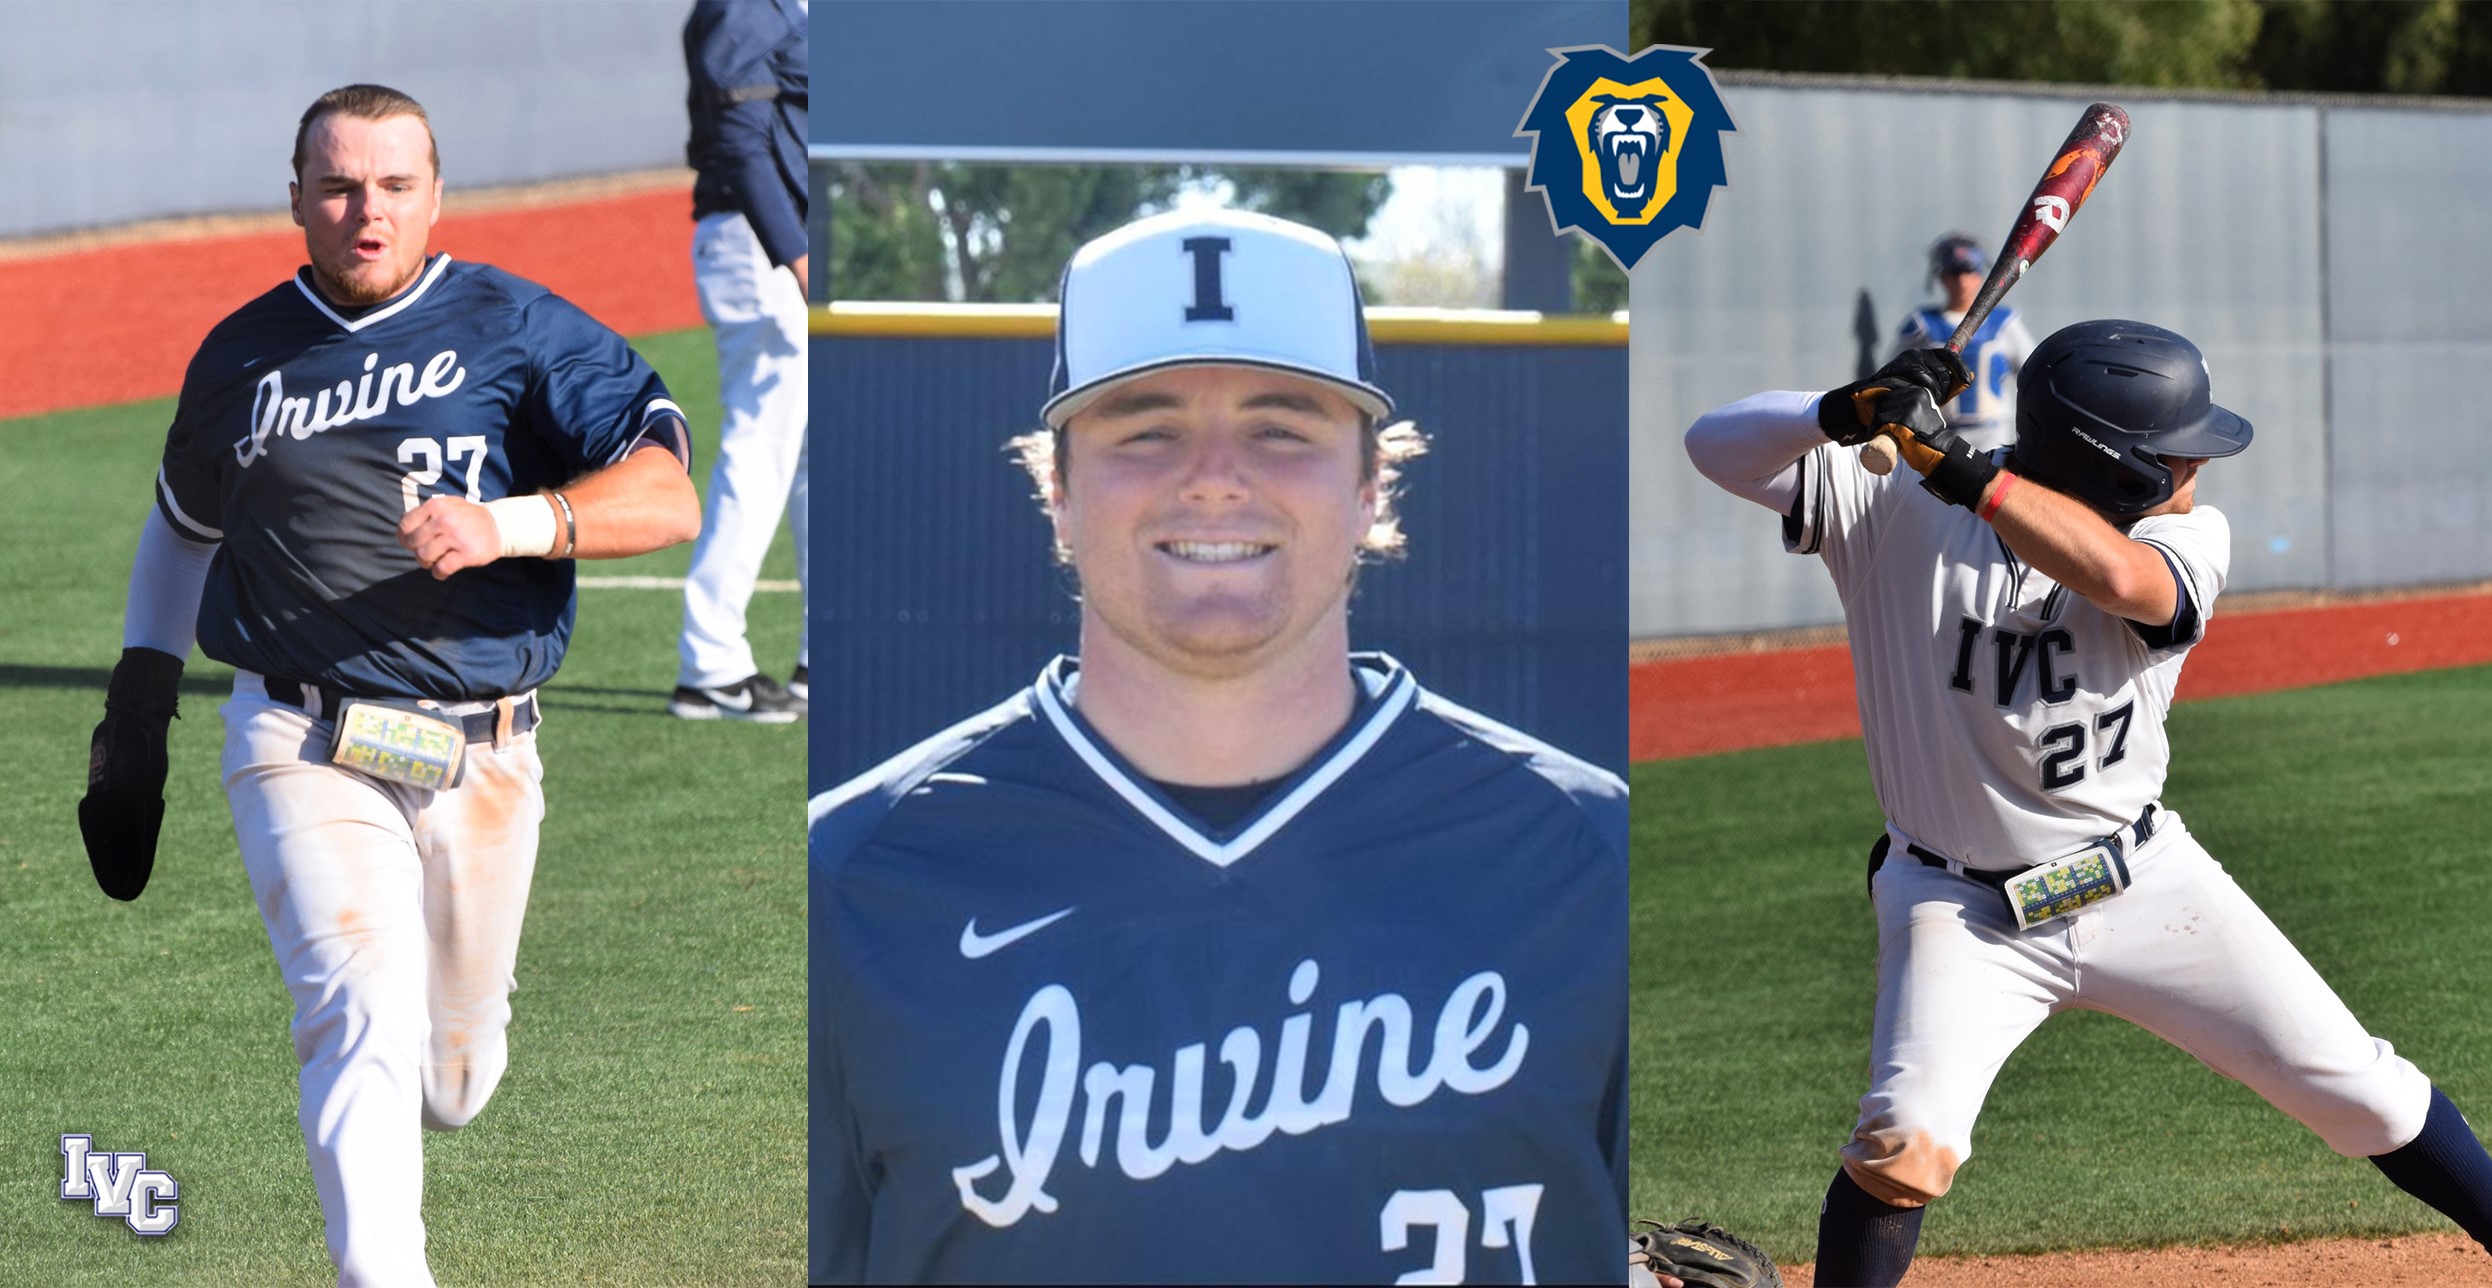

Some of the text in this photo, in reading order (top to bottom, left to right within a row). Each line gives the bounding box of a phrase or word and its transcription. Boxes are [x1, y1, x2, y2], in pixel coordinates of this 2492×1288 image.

[1182, 234, 1235, 323] I
[233, 350, 466, 468] Irvine
[2071, 426, 2121, 460] RAWLINGS
[397, 435, 489, 512] 27
[1949, 613, 2078, 709] IVC
[2037, 693, 2135, 794] 27
[952, 959, 1529, 1228] Irvine
[1381, 1183, 1545, 1286] 27
